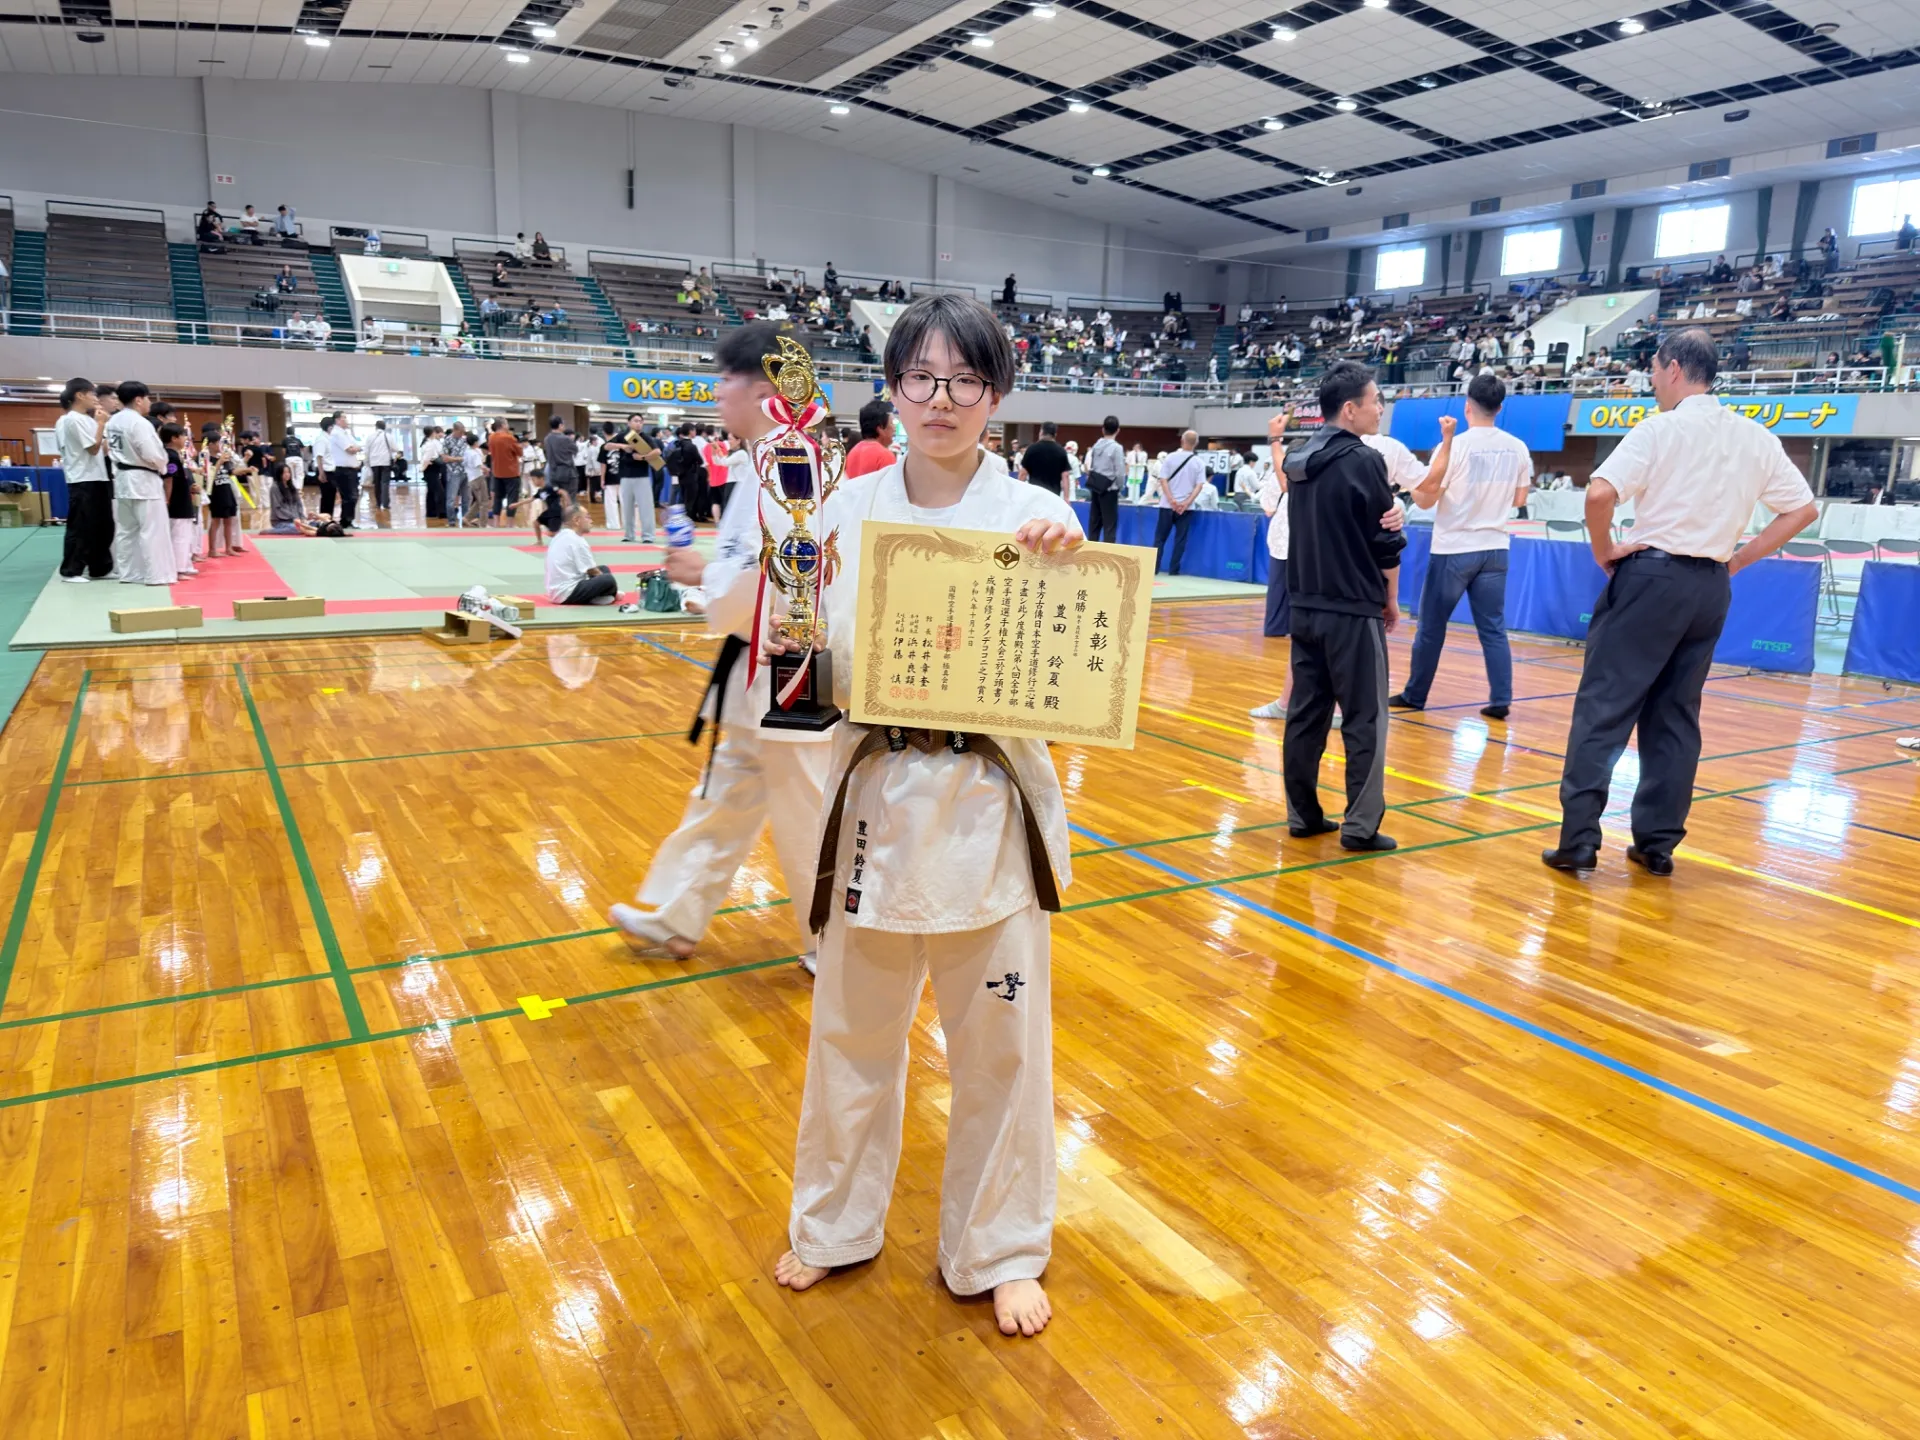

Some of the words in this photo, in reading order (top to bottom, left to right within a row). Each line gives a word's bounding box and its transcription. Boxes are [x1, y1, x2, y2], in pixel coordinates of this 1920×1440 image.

[623, 378, 718, 402] OKBぎふ
[1729, 402, 1838, 429] アリーナ
[1220, 454, 1227, 469] 5
[1075, 589, 1088, 613] 優勝
[1053, 603, 1067, 634] 豊田
[1087, 610, 1109, 672] 表彰状
[1047, 655, 1064, 687] 鈴夏
[1044, 695, 1060, 710] 殿
[852, 820, 868, 885] 豊田鈴夏
